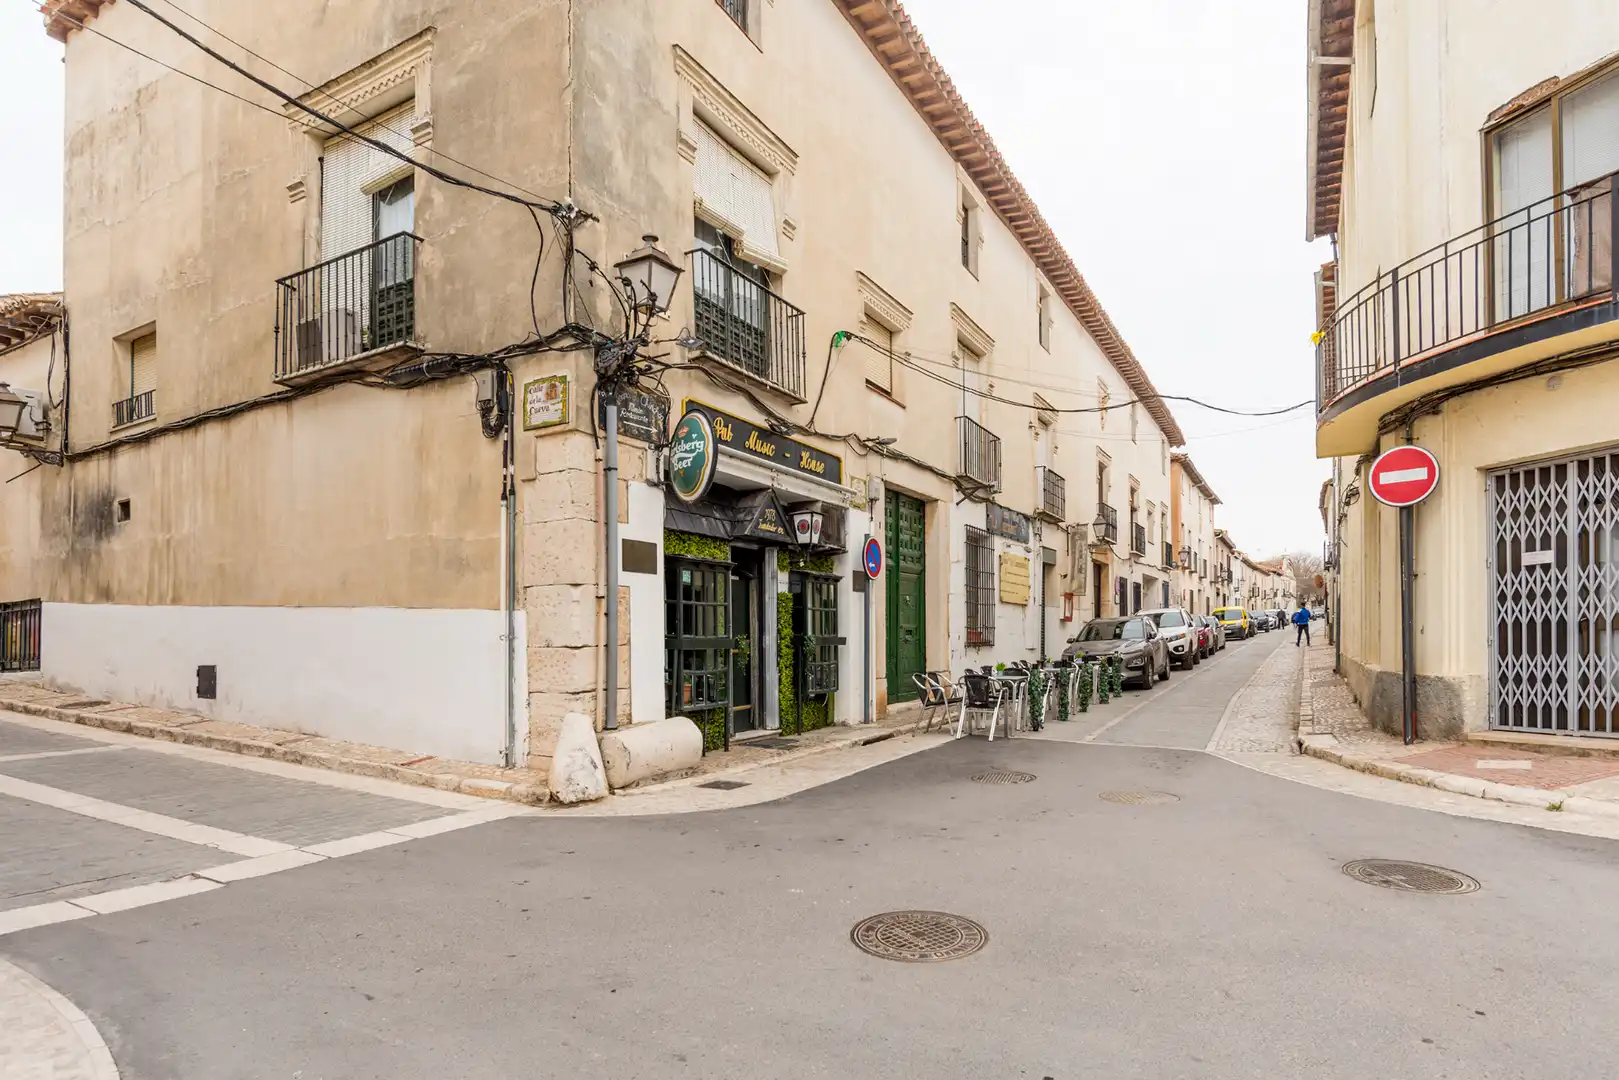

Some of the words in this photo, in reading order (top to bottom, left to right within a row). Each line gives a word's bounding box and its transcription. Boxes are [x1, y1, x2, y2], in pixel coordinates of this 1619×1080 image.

[529, 384, 544, 394] Calle
[713, 416, 733, 442] Pub
[744, 430, 776, 457] Music
[799, 450, 825, 474] House
[672, 456, 693, 471] Beer
